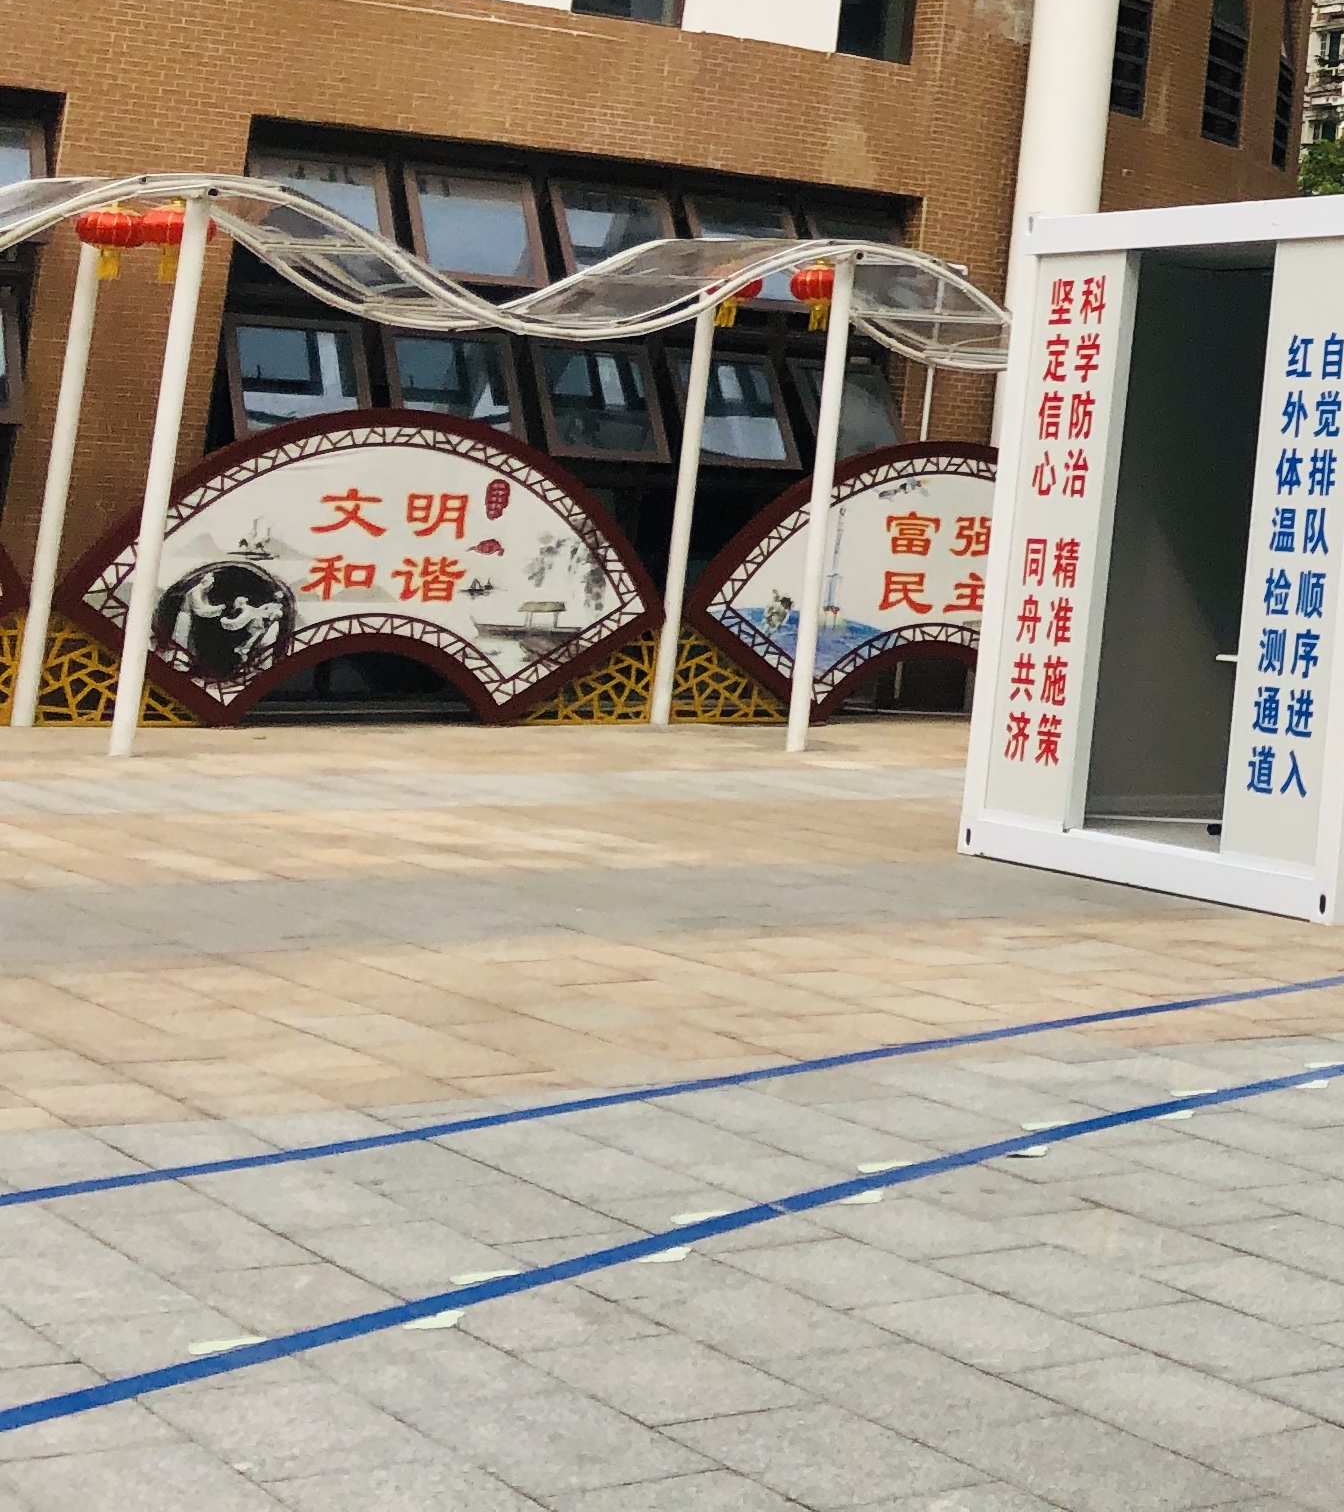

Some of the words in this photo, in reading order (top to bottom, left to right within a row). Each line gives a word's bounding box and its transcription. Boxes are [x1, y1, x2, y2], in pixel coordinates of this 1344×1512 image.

[1032, 279, 1075, 497] 坚定信心
[1062, 275, 1106, 497] 科学防治
[300, 554, 467, 602] 和谐
[310, 488, 468, 539] 文明
[878, 570, 985, 614] 民主
[885, 511, 992, 557] 富强
[1247, 333, 1313, 795] 红外体温检测通道
[1280, 332, 1344, 797] 自觉排队顺序进入
[1005, 537, 1048, 758] 同舟共济
[1035, 538, 1081, 765] 精准施策
